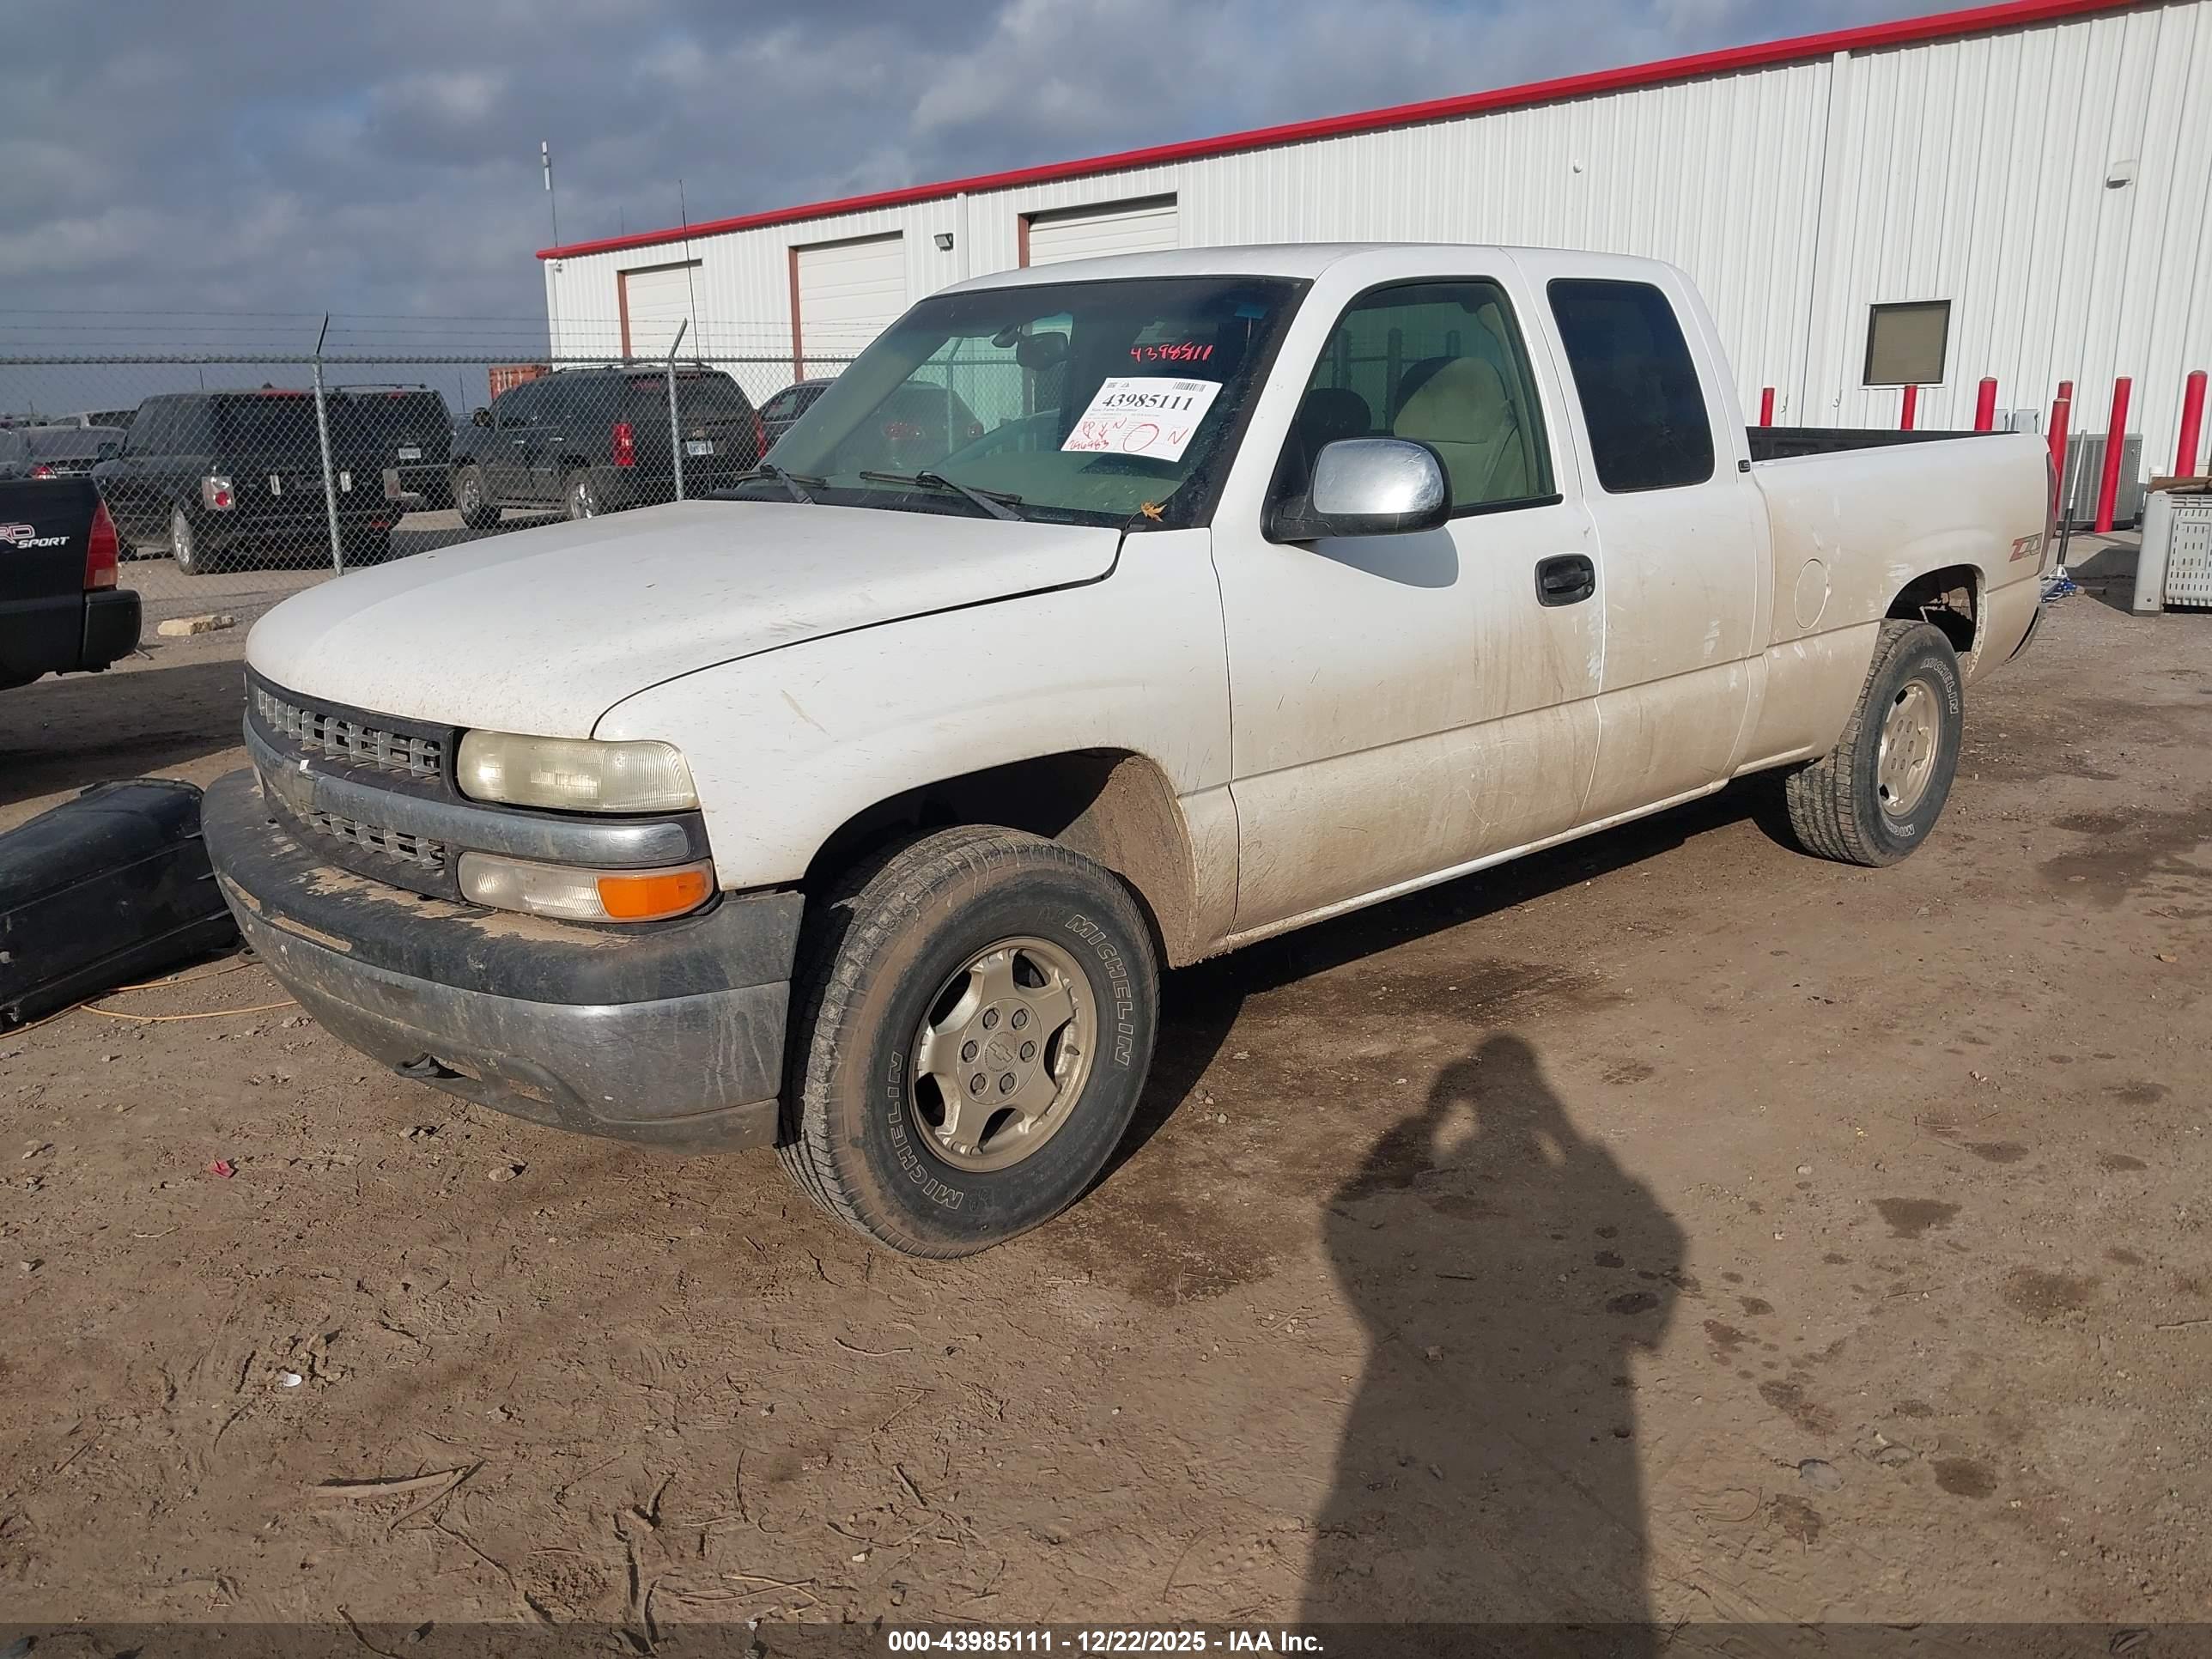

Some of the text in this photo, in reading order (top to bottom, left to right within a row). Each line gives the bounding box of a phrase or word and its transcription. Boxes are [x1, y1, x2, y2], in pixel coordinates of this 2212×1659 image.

[1102, 393, 1194, 410] 43985111
[17, 536, 70, 549] SPORT
[1065, 914, 1134, 1067] MICHELIN
[887, 1049, 964, 1210] MICHELIN
